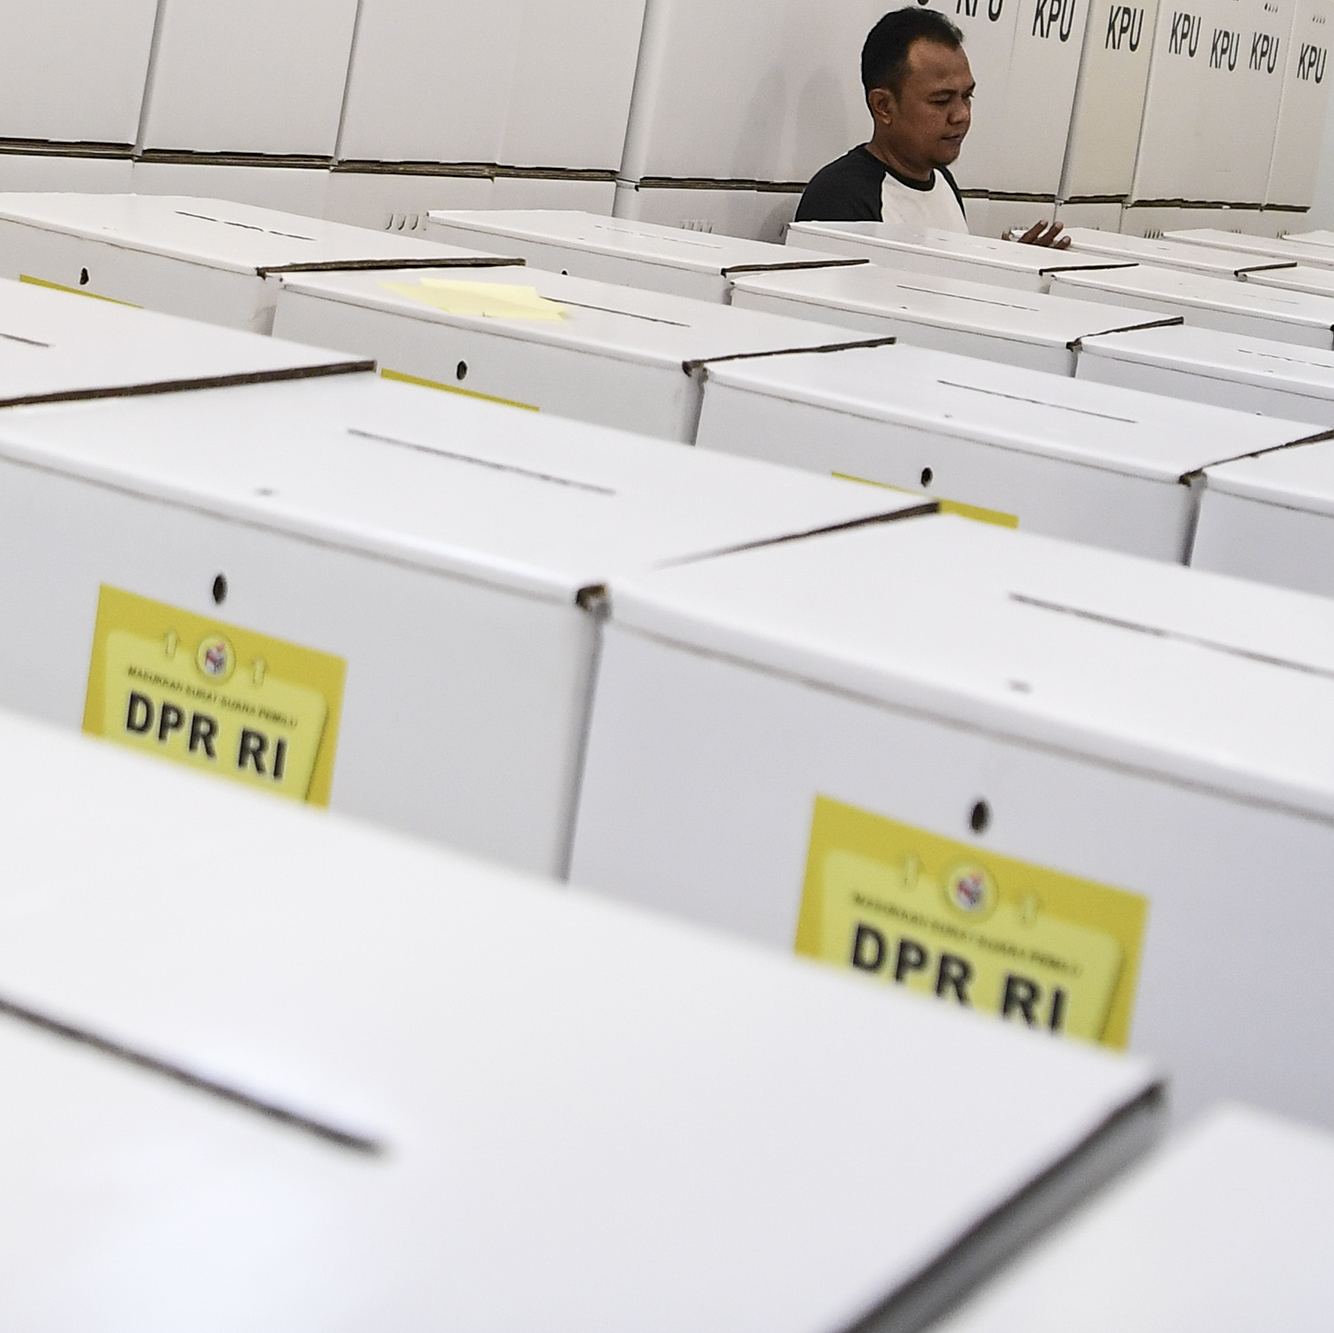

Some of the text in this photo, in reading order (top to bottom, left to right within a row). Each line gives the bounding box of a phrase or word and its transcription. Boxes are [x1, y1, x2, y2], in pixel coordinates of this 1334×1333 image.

[1104, 4, 1145, 53] KPU
[1168, 11, 1202, 58] KPU
[1209, 28, 1242, 73] KPU
[1248, 31, 1281, 75] KPU
[1296, 42, 1328, 85] KPU
[125, 689, 289, 781] DPR RI
[851, 922, 973, 1007] DPR
[1002, 973, 1066, 1033] RI
